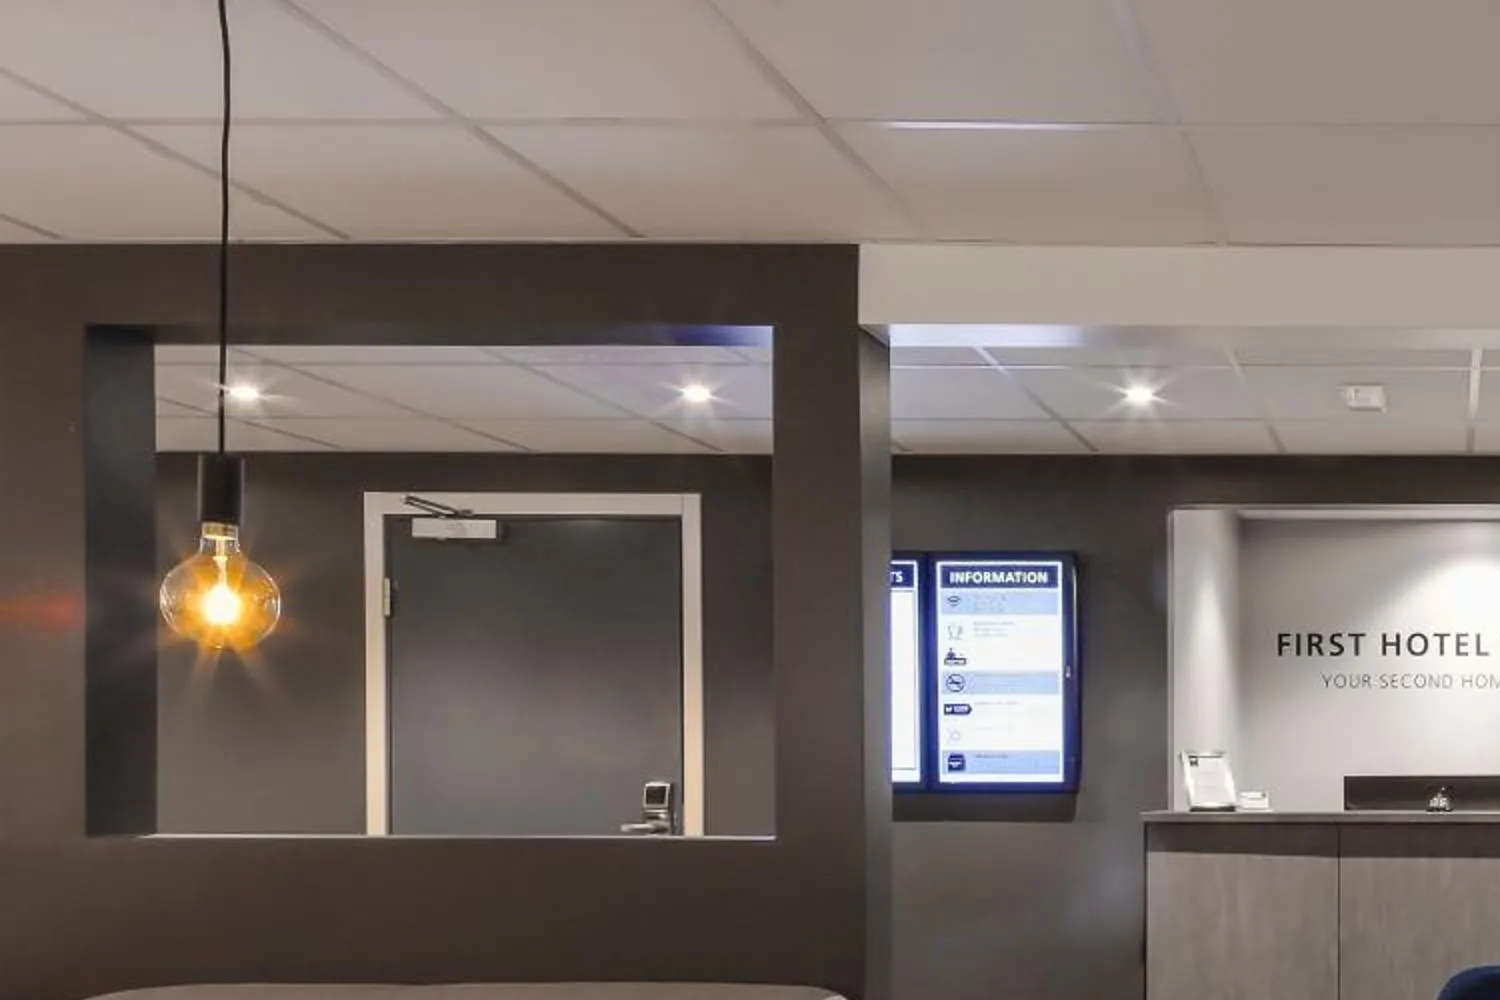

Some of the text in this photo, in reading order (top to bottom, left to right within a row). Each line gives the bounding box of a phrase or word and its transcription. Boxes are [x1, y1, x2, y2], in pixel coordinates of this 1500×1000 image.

[949, 571, 1049, 584] INFORMATION
[1277, 632, 1366, 657] FIRST
[1381, 632, 1490, 657] HOTEL
[1322, 673, 1372, 689] YOUR
[1379, 673, 1454, 689] SECOND
